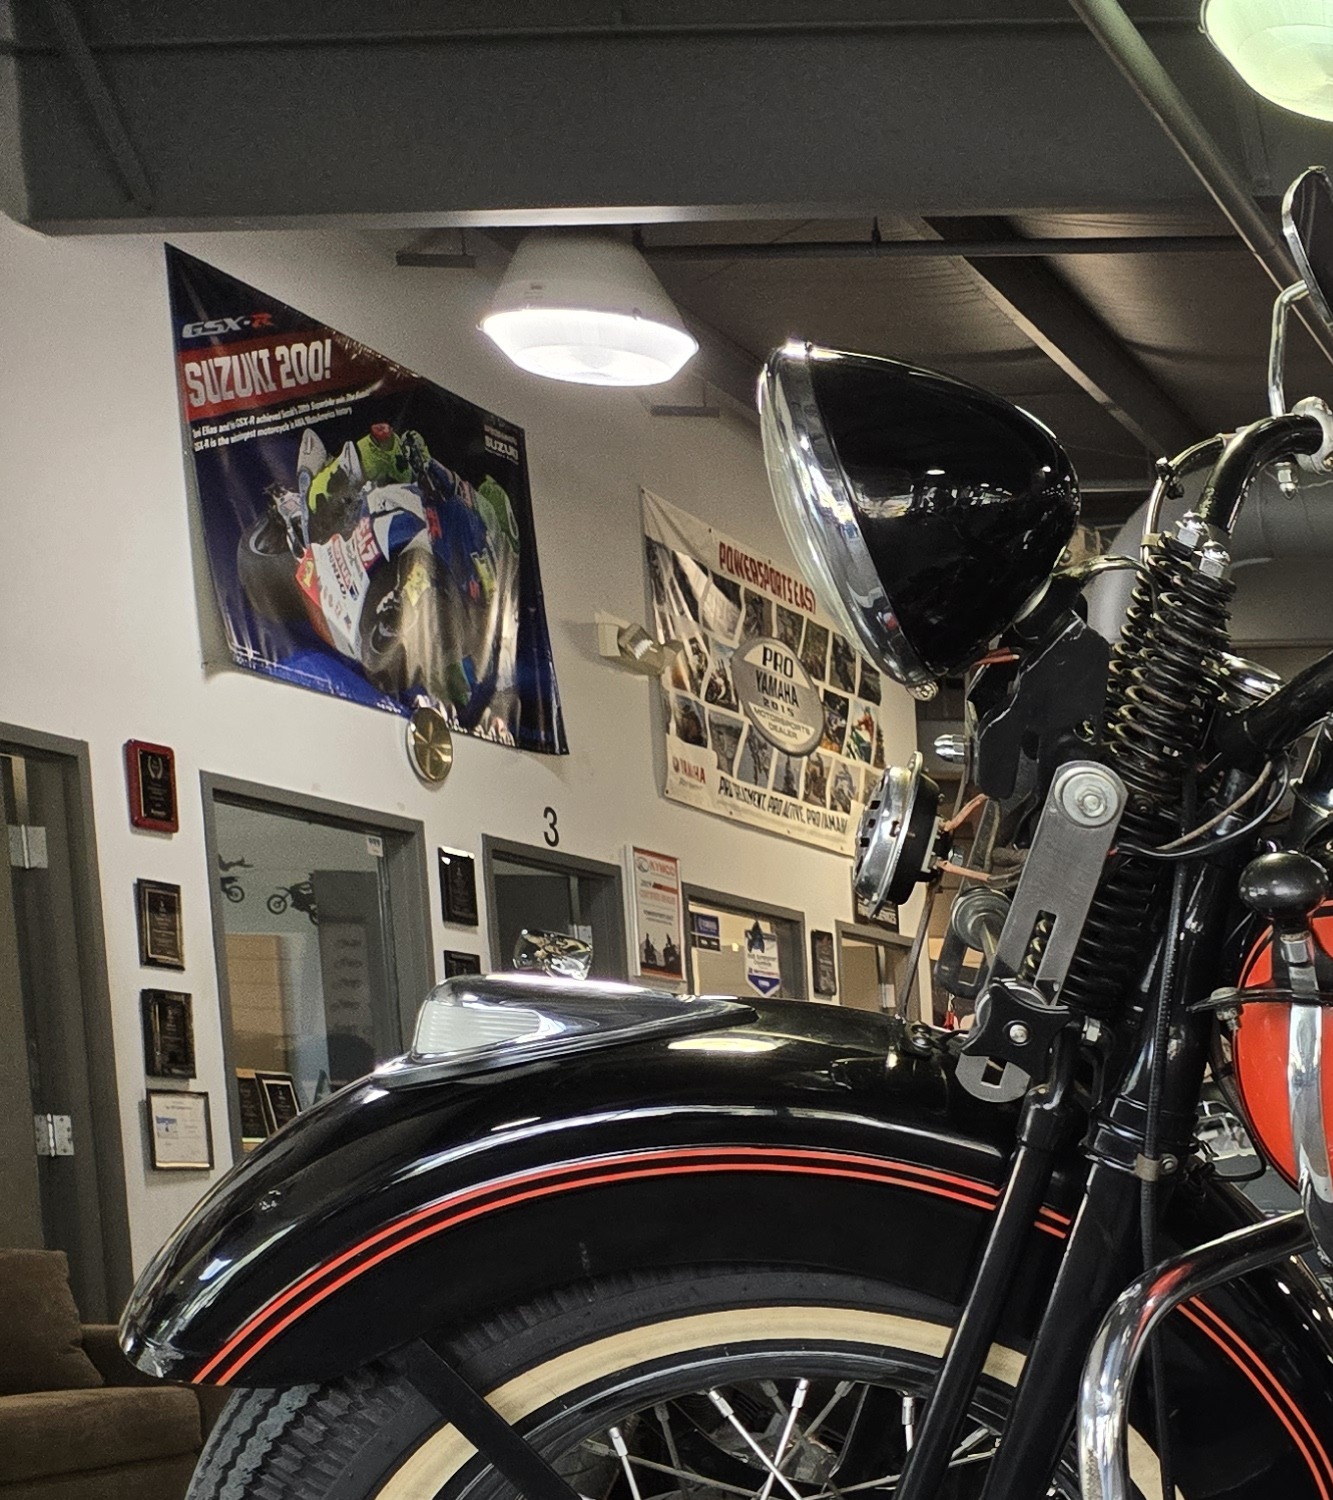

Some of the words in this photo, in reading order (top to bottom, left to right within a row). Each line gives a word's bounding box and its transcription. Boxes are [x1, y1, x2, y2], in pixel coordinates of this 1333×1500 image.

[182, 312, 275, 339] GSX-R
[184, 348, 277, 407] SUZUKI
[275, 339, 332, 389] 200!
[719, 541, 793, 604] POWERSPORTS
[762, 646, 793, 678] PRO
[755, 669, 800, 708] YAMAHA
[763, 696, 795, 717] 2015
[543, 806, 559, 847] 3
